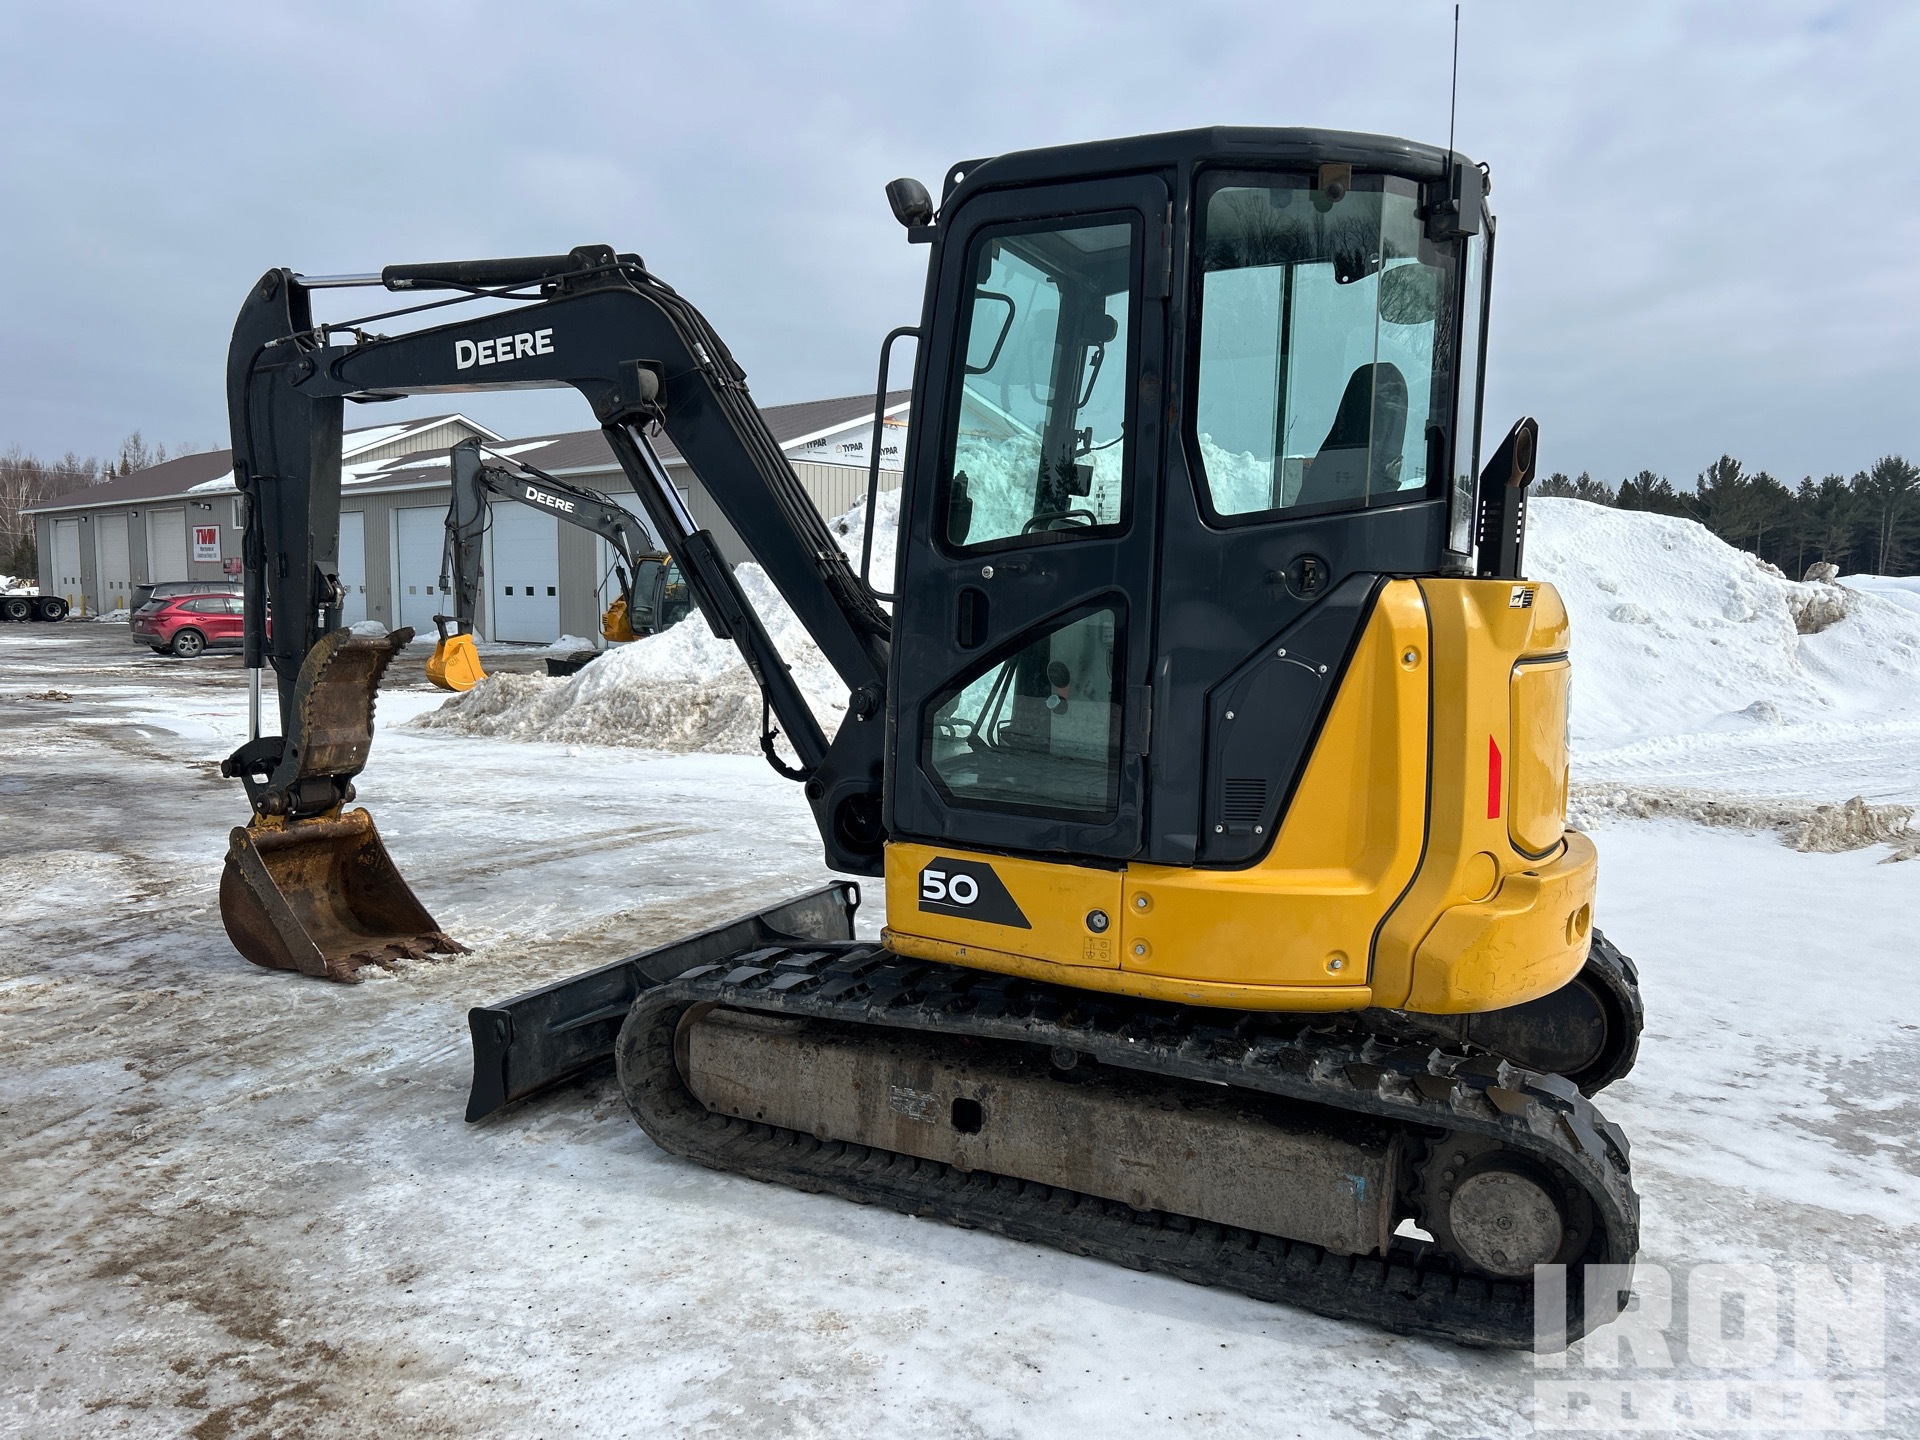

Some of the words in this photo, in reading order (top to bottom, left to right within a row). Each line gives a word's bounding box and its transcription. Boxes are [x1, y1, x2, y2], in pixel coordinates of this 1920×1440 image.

[455, 328, 554, 370] DEERE
[842, 442, 864, 453] TYPAR
[525, 486, 575, 513] DEERE
[922, 869, 979, 905] 50
